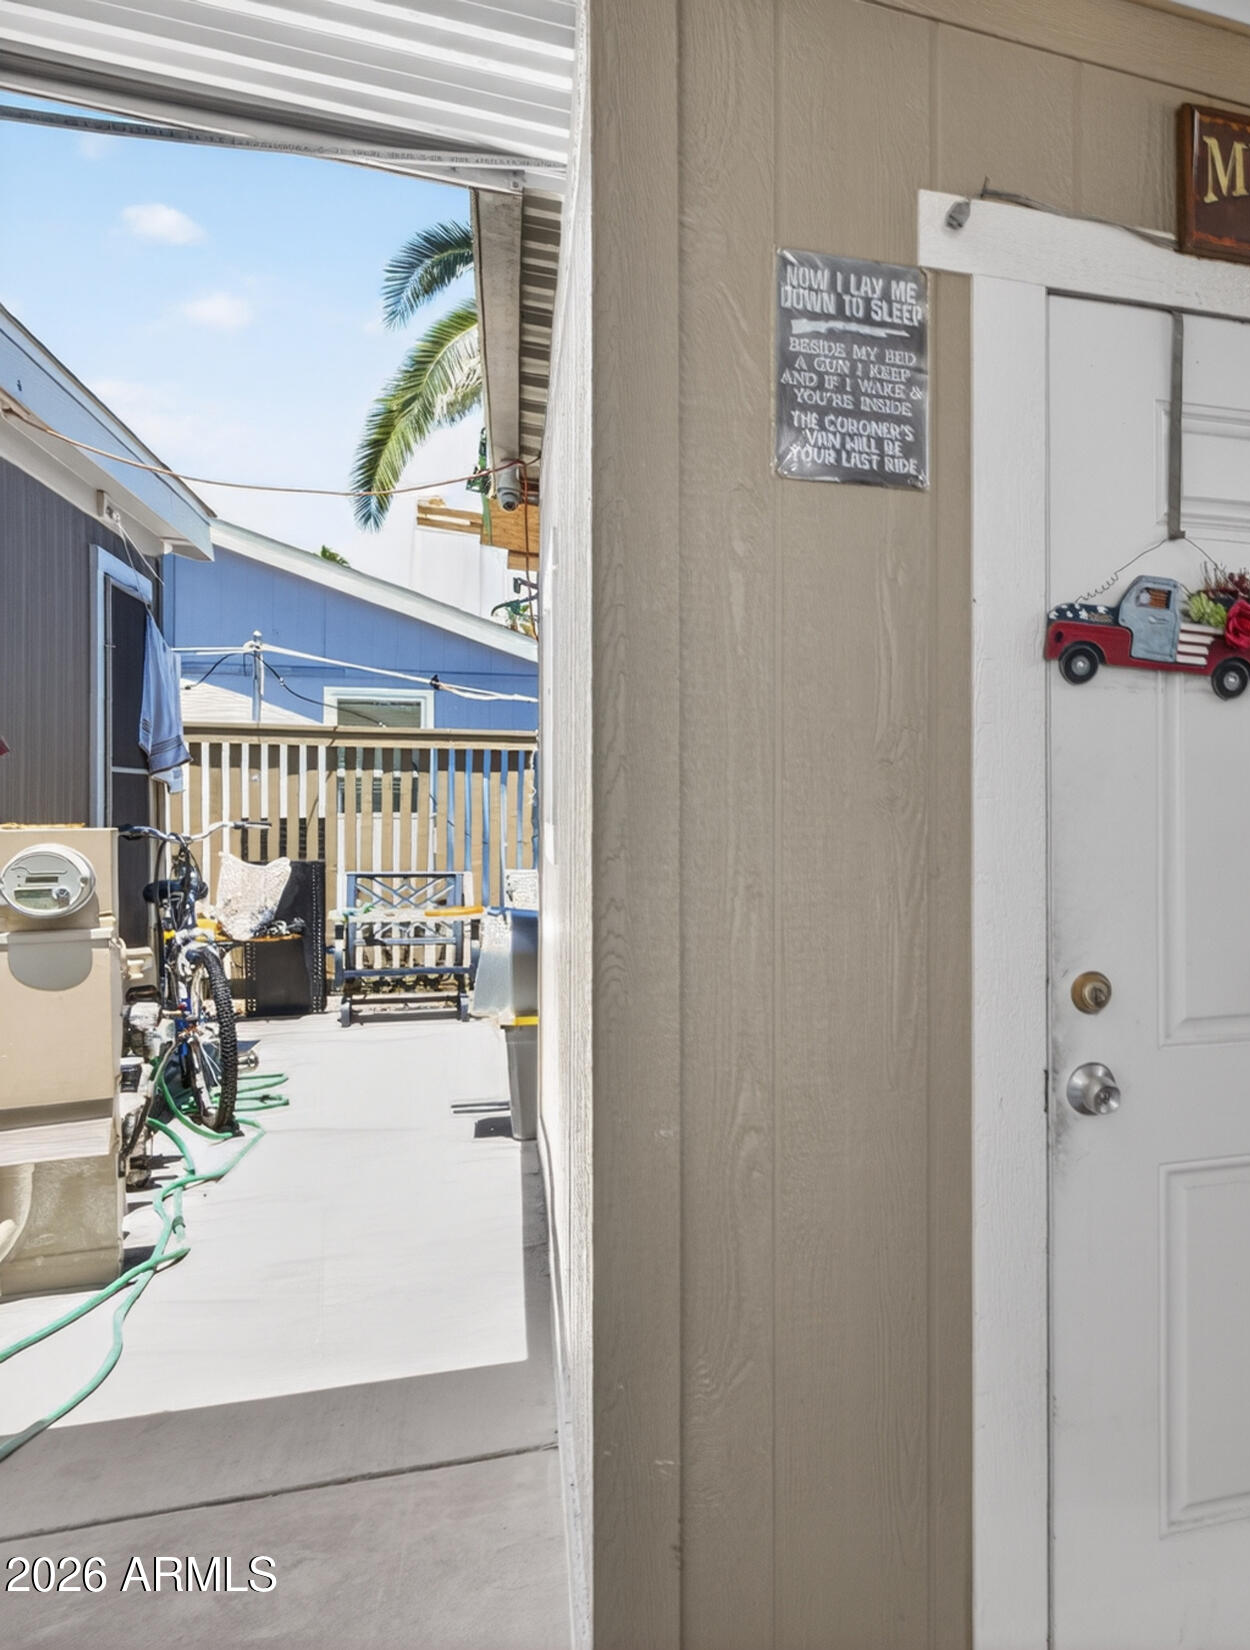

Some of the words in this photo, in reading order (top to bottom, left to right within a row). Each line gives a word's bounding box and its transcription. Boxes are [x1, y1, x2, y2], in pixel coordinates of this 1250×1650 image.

[786, 265, 830, 291] NOW
[836, 271, 842, 294] I
[850, 273, 883, 298] LAY
[891, 280, 918, 304] ME
[781, 286, 837, 315] DOWN
[843, 295, 865, 319] TO
[871, 300, 922, 327] SLEEP
[789, 337, 847, 358] BESIDE
[852, 344, 878, 361] MY
[885, 349, 917, 366] BED
[781, 367, 818, 386] AND
[824, 374, 840, 389] IF
[846, 378, 852, 391] I
[858, 378, 906, 399] WAKE
[910, 385, 923, 400] &
[794, 354, 808, 370] A
[814, 357, 850, 374] GUN
[856, 362, 862, 377] I
[869, 364, 911, 382] KEEP
[793, 388, 854, 409] YOU'RE
[860, 396, 913, 417] INSIDE
[791, 410, 819, 429] THE
[825, 413, 915, 442] CORONER'S
[790, 443, 837, 465] YOUR
[841, 450, 881, 471] LAST
[884, 457, 918, 475] RIDE
[804, 429, 841, 449] VAN
[845, 435, 880, 454] WILL
[884, 440, 903, 457] BE
